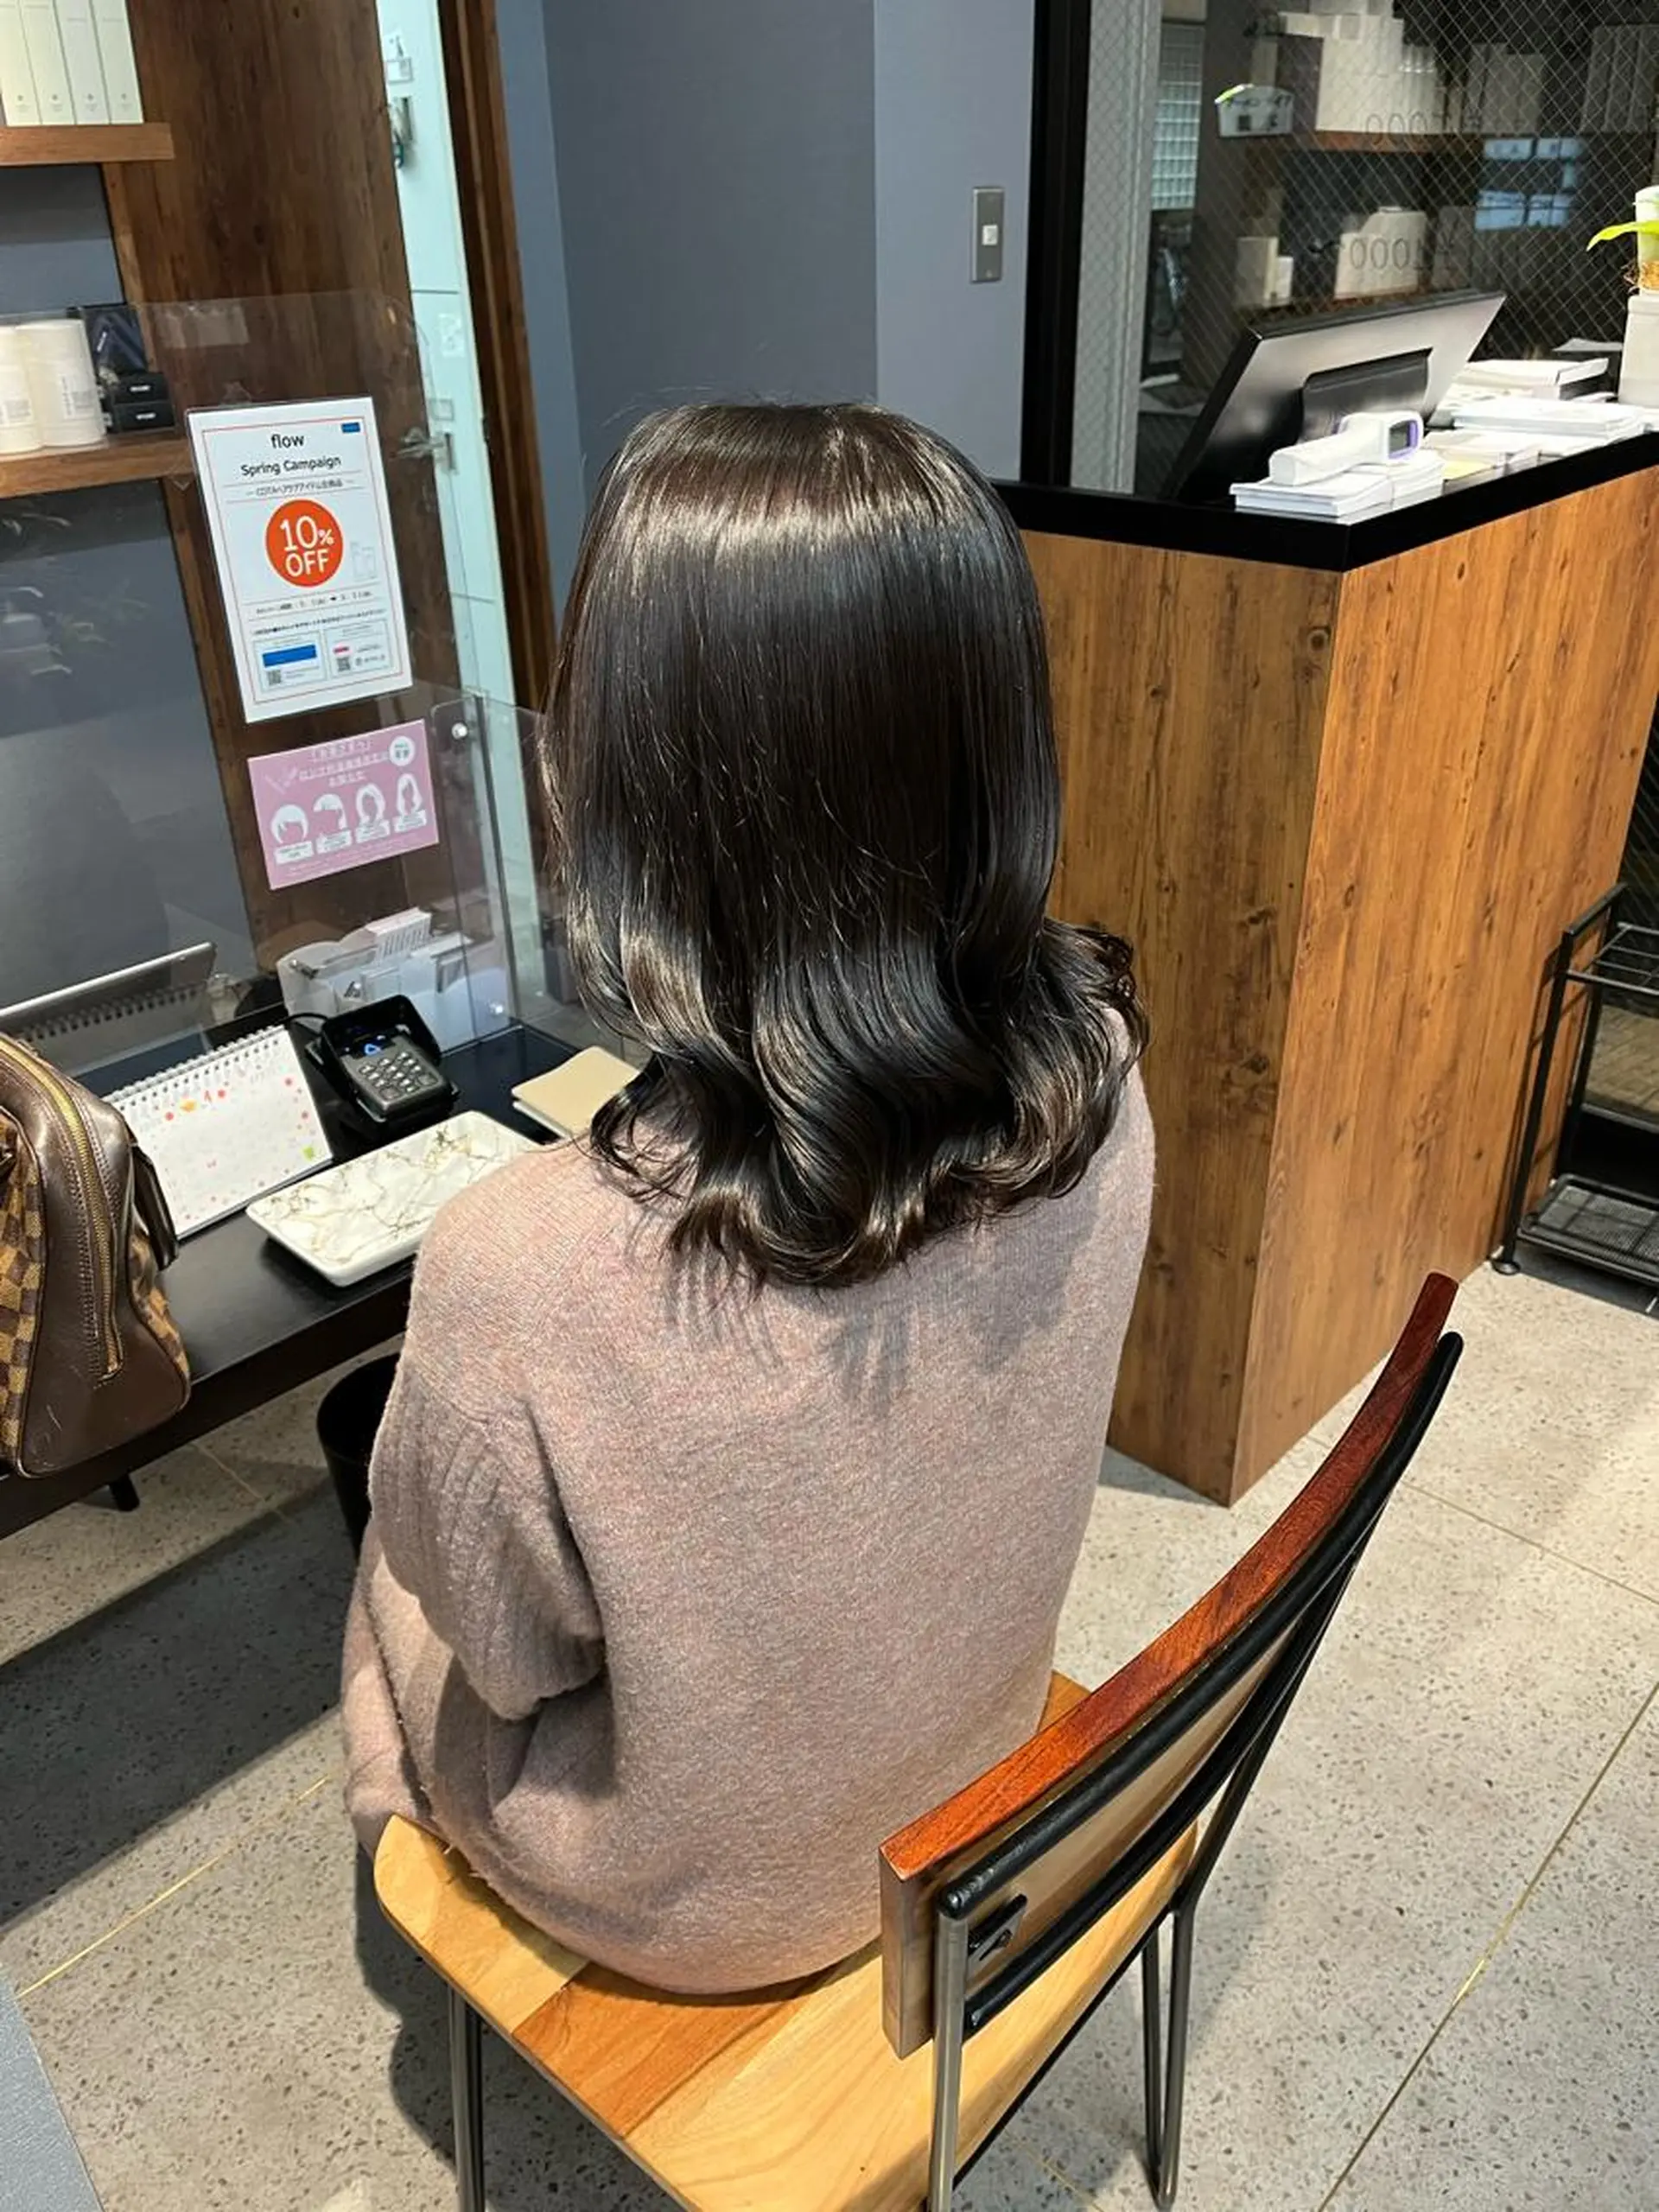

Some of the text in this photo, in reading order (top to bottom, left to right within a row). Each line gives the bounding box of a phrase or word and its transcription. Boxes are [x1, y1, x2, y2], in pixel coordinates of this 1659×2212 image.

[270, 434, 304, 448] flow
[240, 456, 341, 477] Spring Campaign
[280, 515, 334, 551] 10%
[285, 550, 329, 577] OFF
